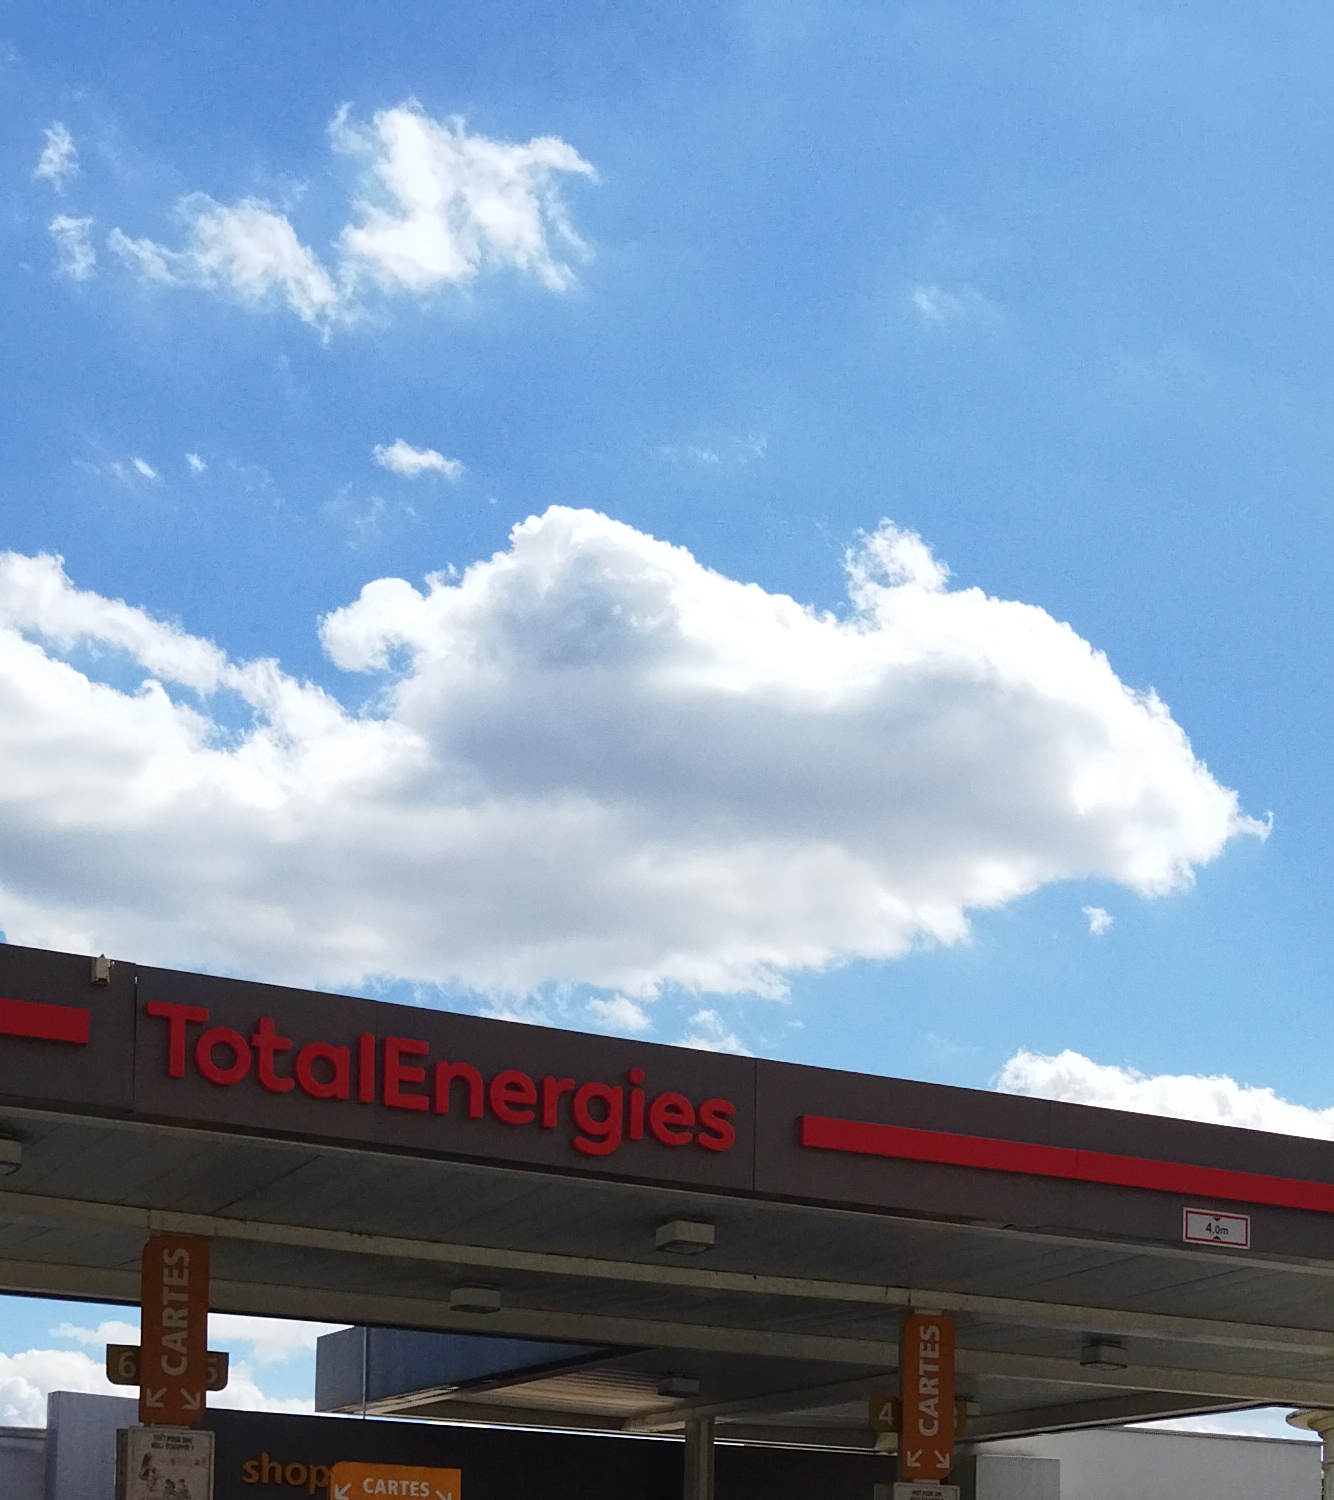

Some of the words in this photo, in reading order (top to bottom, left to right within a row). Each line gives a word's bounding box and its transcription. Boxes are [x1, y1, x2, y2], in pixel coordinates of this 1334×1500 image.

[147, 1001, 736, 1157] TotalEnergies
[161, 1246, 190, 1376] CARTES
[119, 1351, 136, 1378] 6
[919, 1325, 939, 1437] CARTES
[878, 1402, 894, 1425] 4
[242, 1451, 331, 1495] shop
[362, 1477, 430, 1497] CARTES
